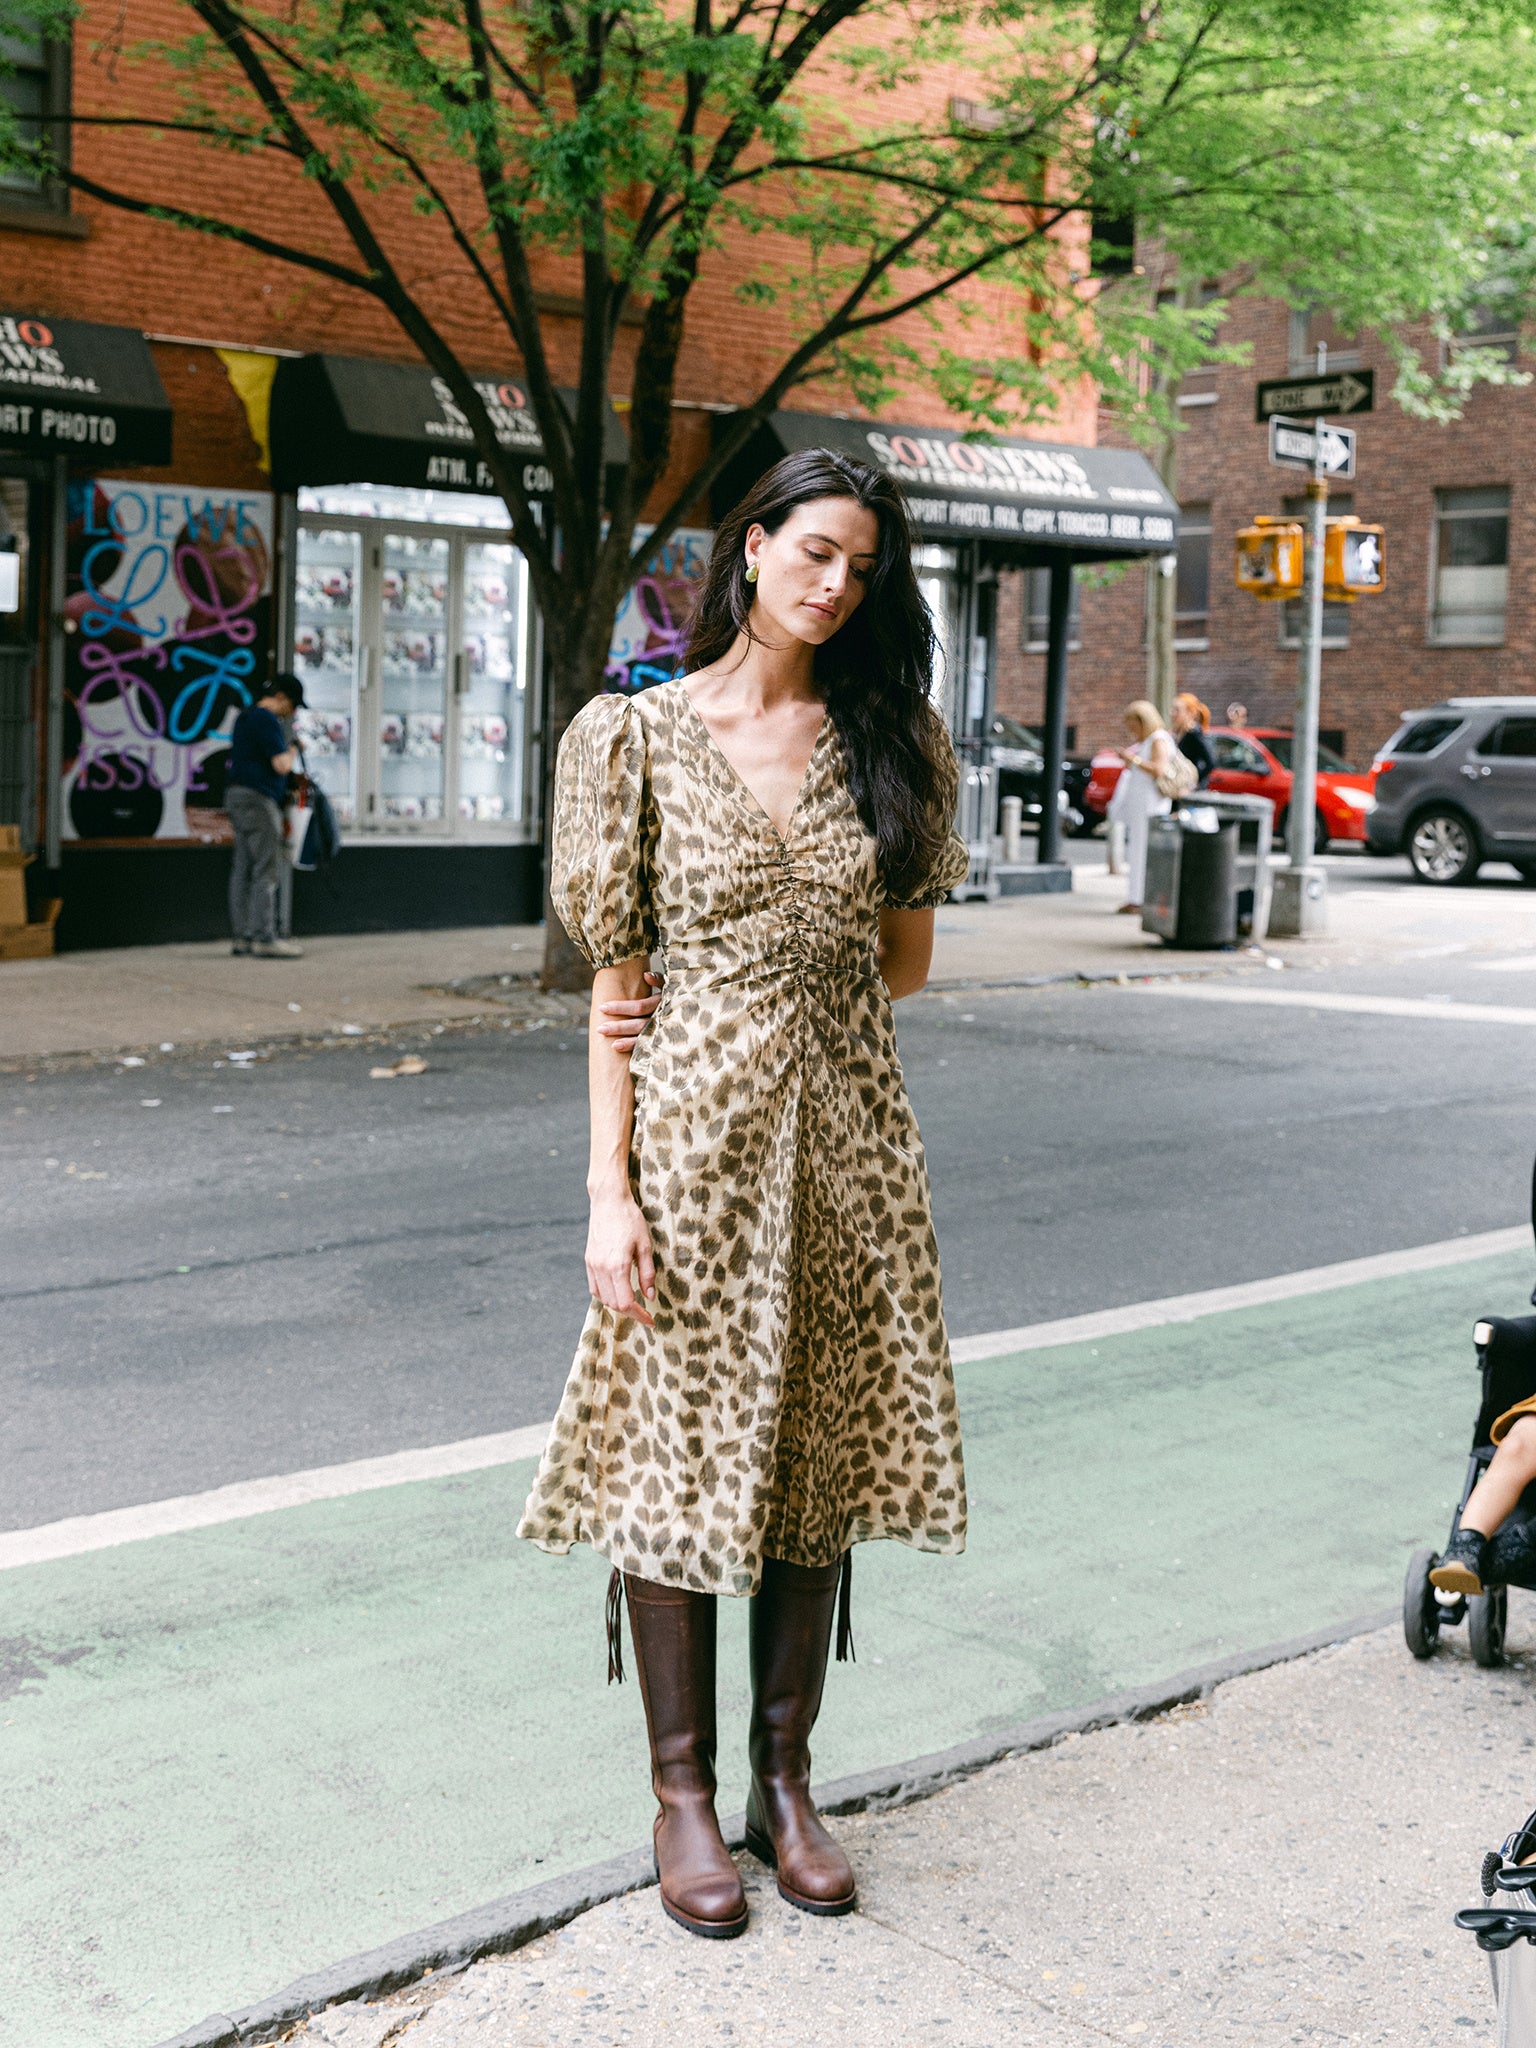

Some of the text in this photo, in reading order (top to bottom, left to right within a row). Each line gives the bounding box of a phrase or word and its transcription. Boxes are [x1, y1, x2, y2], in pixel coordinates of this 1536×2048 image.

[41, 408, 117, 446] PHOTO
[82, 484, 258, 547] LOEWE
[77, 744, 209, 791] ISSUE
